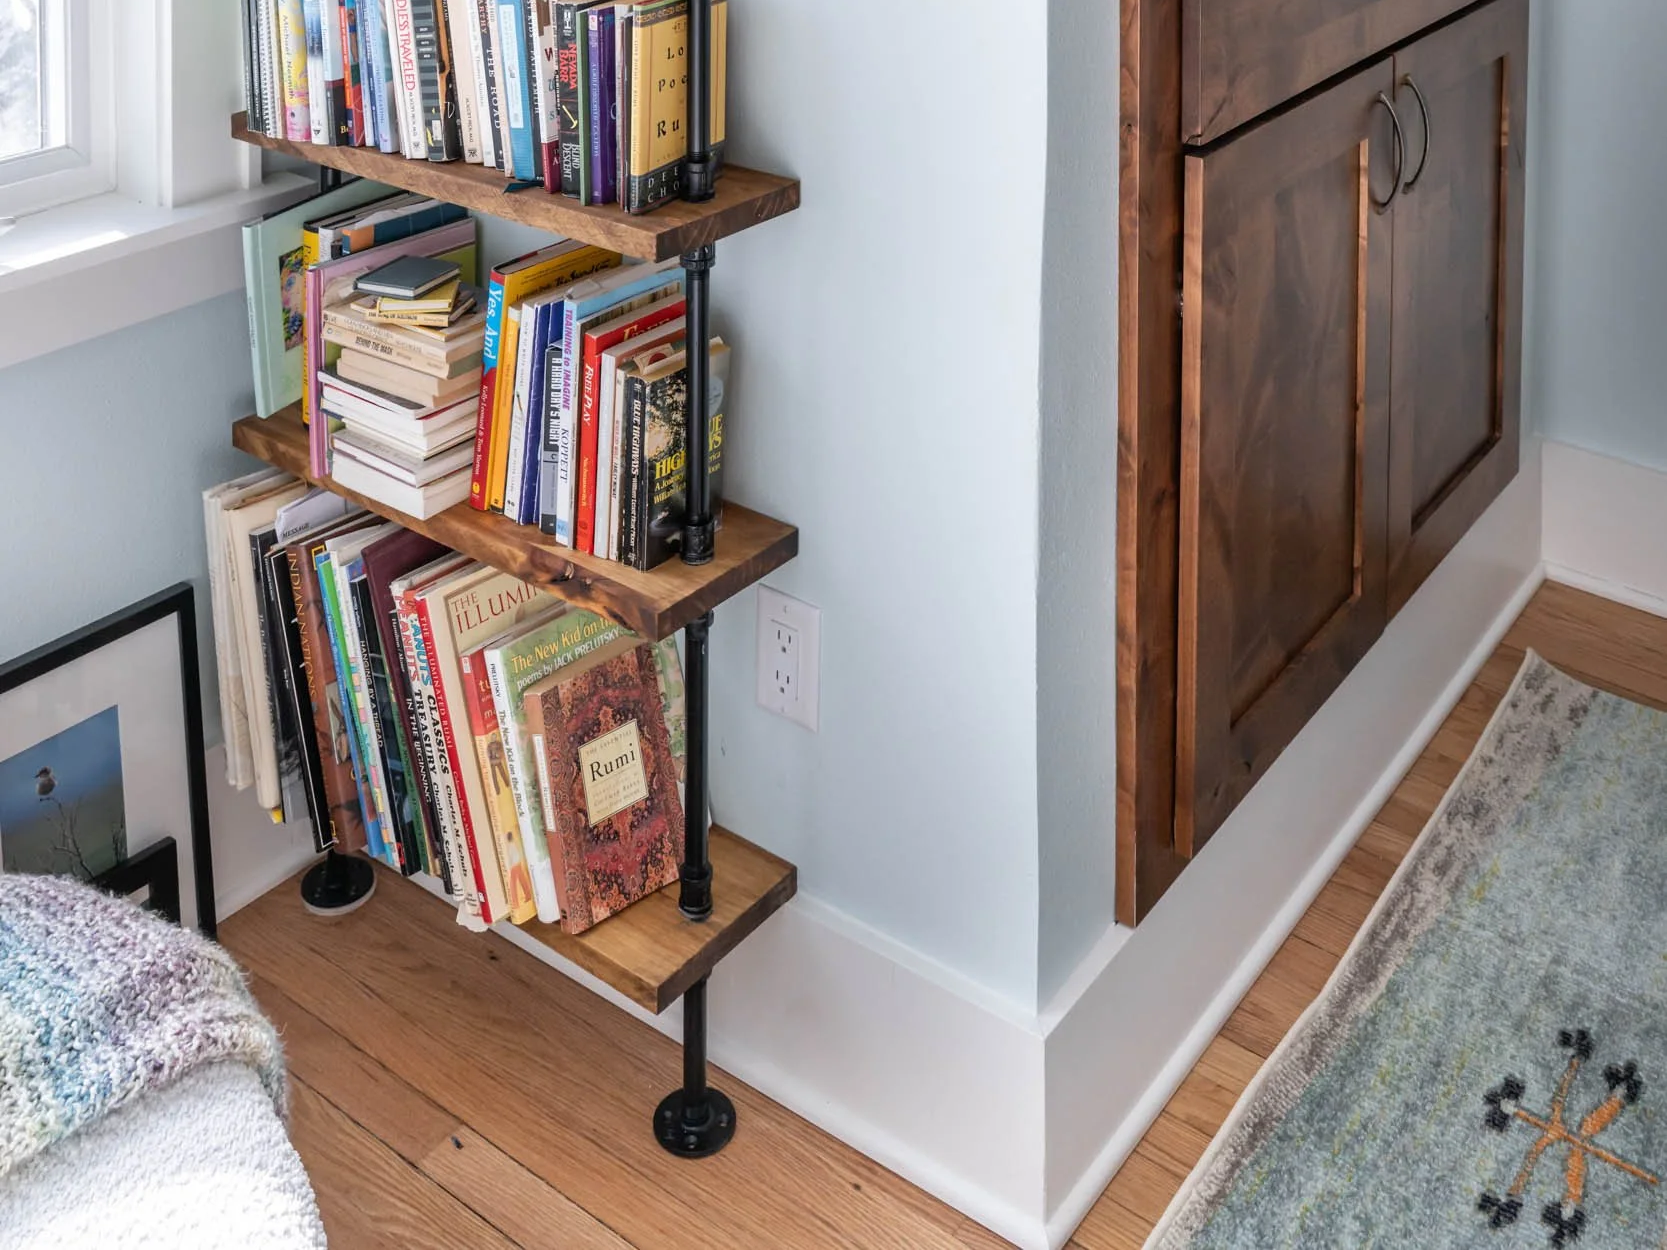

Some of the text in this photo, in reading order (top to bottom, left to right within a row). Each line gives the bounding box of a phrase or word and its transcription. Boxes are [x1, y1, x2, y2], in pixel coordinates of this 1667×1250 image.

[396, 3, 410, 31] LESS
[282, 14, 295, 100] Michael Nesmith
[399, 34, 416, 91] TRAVELED
[559, 49, 569, 82] BARR
[568, 43, 577, 90] NEVADA
[486, 47, 502, 130] THE ROAD
[563, 143, 573, 182] DESCENT
[571, 143, 580, 169] BLIND
[483, 325, 496, 360] And
[562, 308, 573, 411] TRAINING to IMAGINE
[481, 384, 489, 402] Kelly
[551, 365, 562, 390] HARD
[582, 363, 594, 426] FREE PLAY
[479, 402, 487, 429] Leonard
[550, 392, 561, 417] DAY'S
[632, 399, 642, 424] BLUE
[549, 419, 560, 446] NIGHT
[631, 425, 641, 475] HIGHWAYS
[559, 427, 570, 484] KOPPETT
[286, 552, 317, 697] INDIAN NATIONS
[451, 580, 538, 634] THE ILLUMI
[511, 622, 597, 674] The New Kid on
[517, 626, 619, 692] poems by JACK PRELUTSKY
[359, 639, 373, 686] HANGING
[367, 688, 375, 701] BY
[372, 711, 384, 749] THREAD
[419, 615, 453, 749] THE ILLUMINATED RUMI
[489, 663, 501, 698] PRELUTSKY
[405, 697, 415, 710] IN
[498, 710, 509, 726] The
[409, 714, 421, 736] THE
[501, 727, 512, 747] New
[413, 689, 439, 775] TREASURY
[431, 781, 445, 824] Charles
[413, 740, 432, 803] BEGINNING
[426, 693, 450, 774] CLASSICS
[444, 783, 459, 827] Charles
[453, 827, 461, 841] M.
[504, 747, 515, 762] Kid
[508, 763, 517, 776] on
[590, 743, 635, 782] Rumi
[510, 777, 520, 791] the
[513, 793, 525, 818] Block
